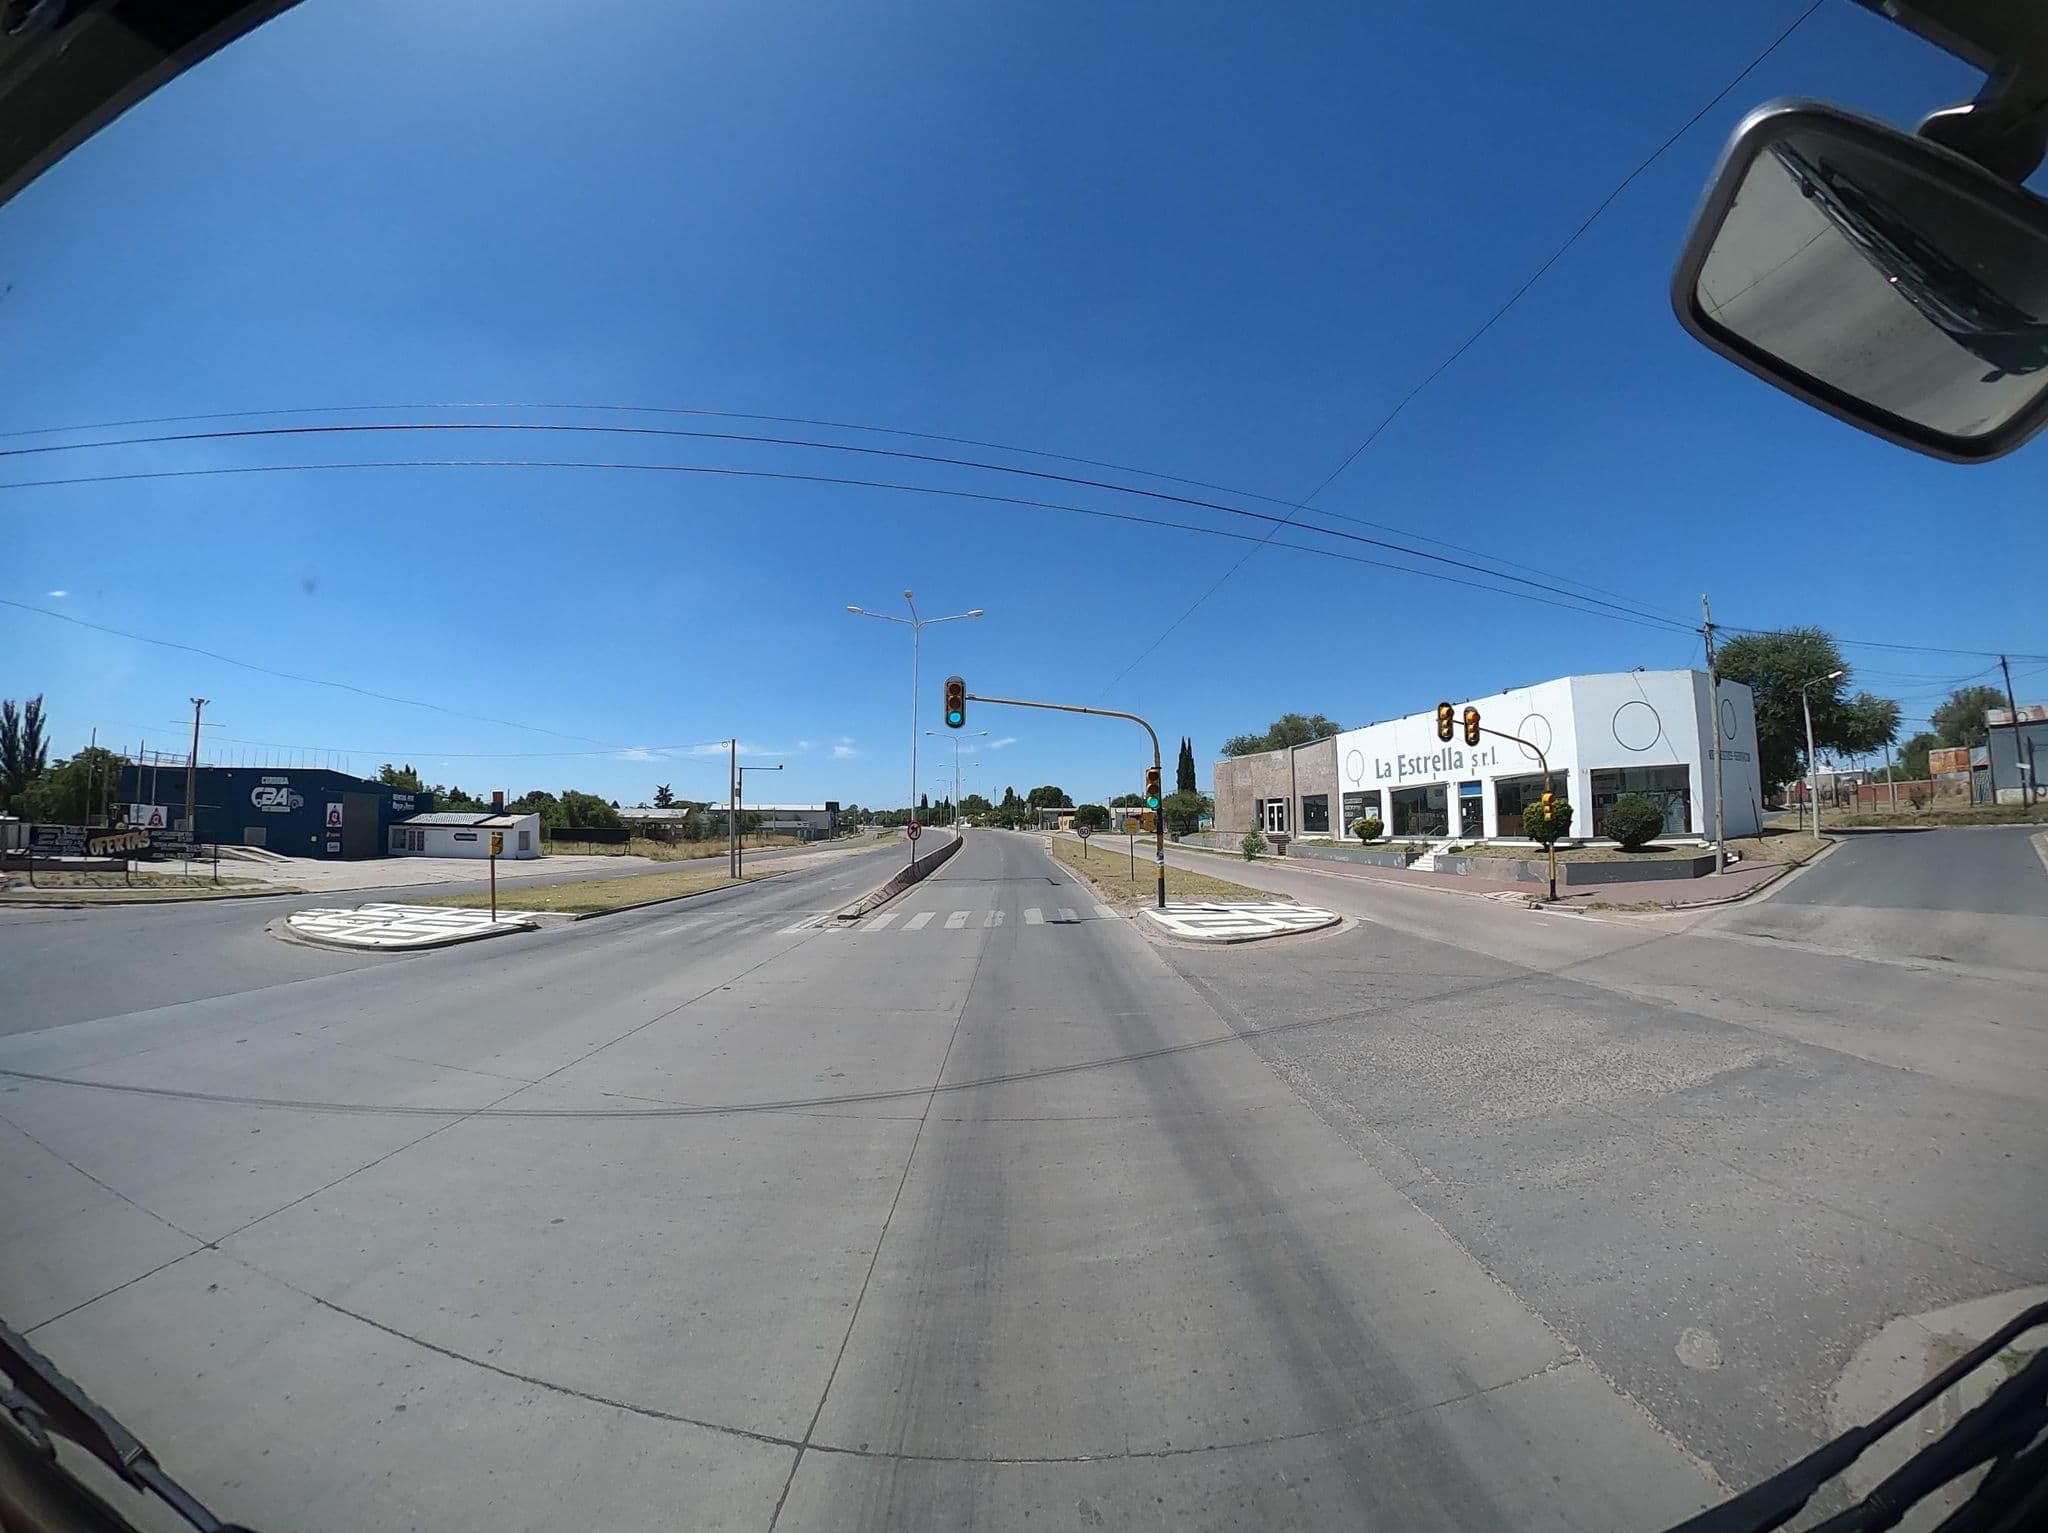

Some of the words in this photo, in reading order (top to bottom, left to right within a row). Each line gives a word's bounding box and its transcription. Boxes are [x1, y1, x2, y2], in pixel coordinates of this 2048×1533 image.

[1375, 758, 1392, 779] La
[1398, 747, 1464, 777] Estrella
[89, 830, 151, 856] OFERTAS
